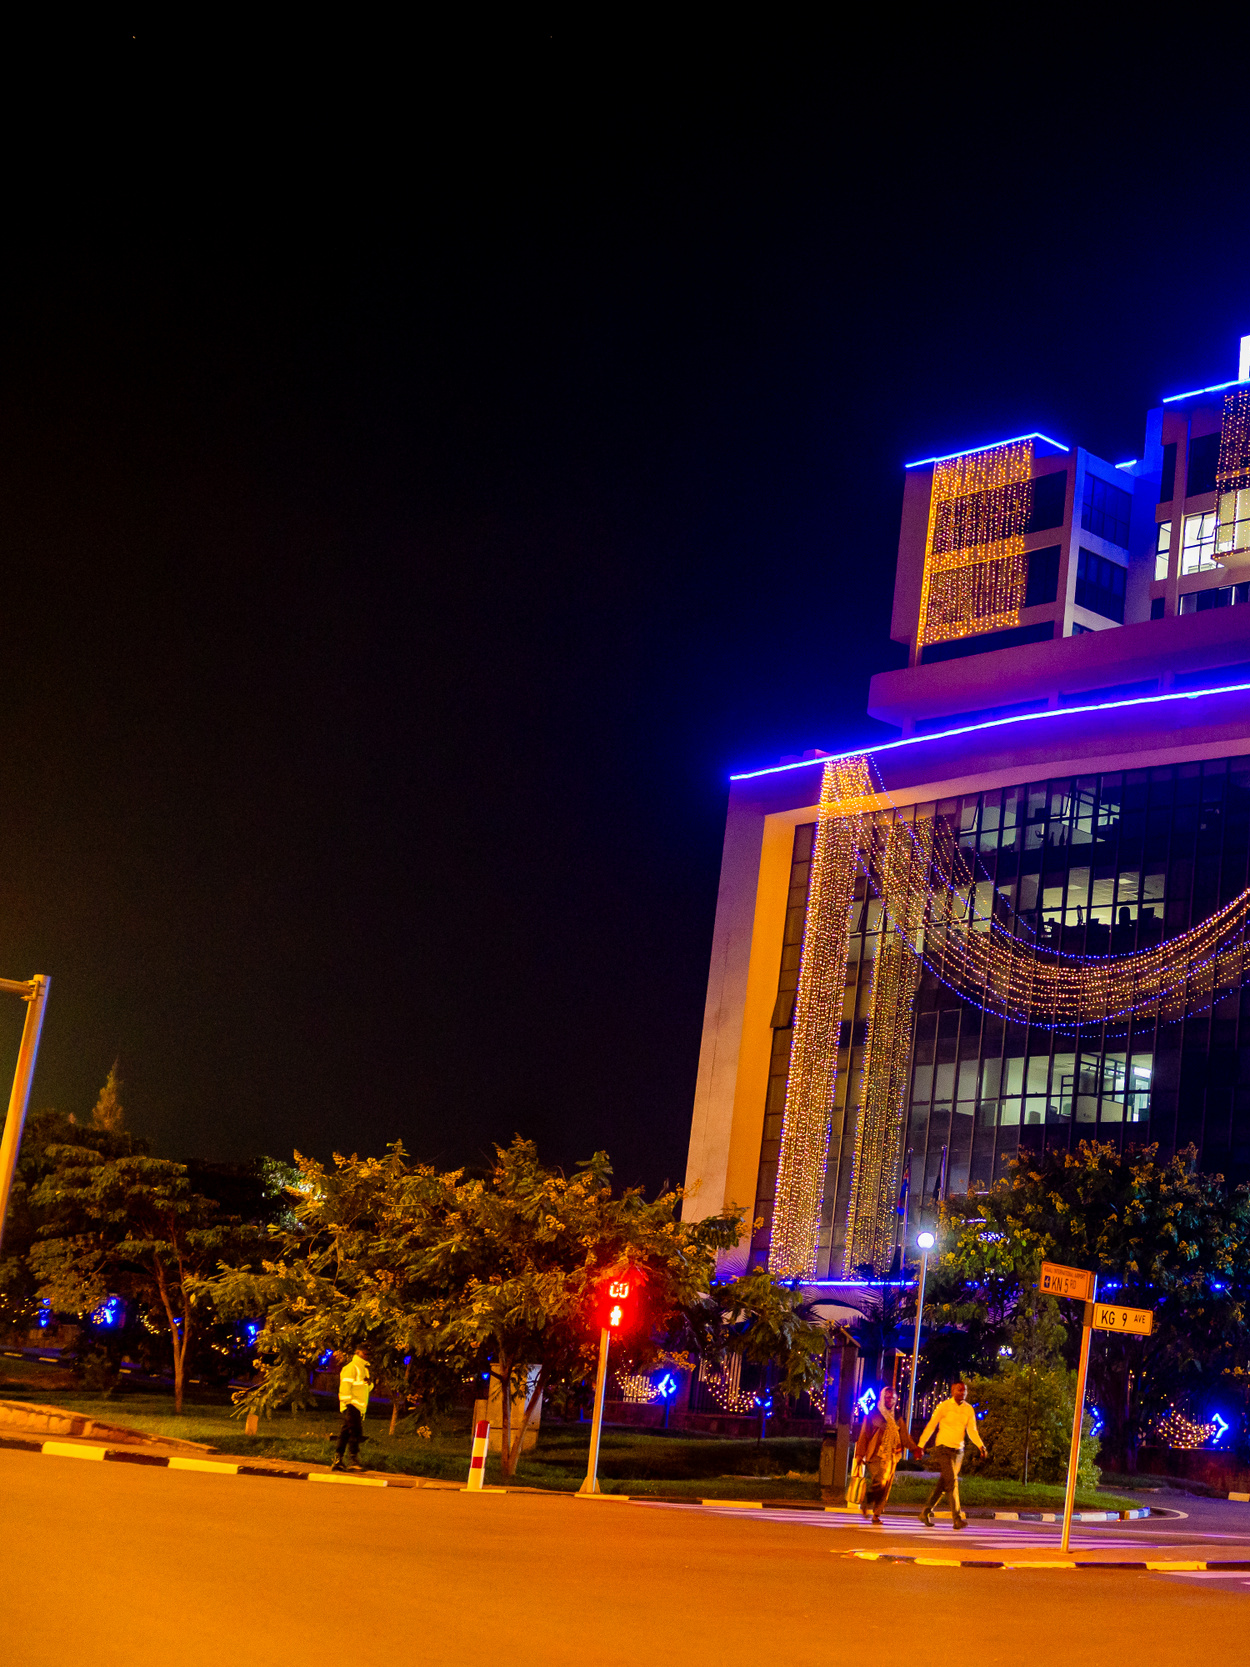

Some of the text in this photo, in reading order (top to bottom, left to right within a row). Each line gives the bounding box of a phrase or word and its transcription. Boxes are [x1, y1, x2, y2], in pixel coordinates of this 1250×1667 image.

[1051, 1276, 1077, 1294] KN 5 RD
[1101, 1310, 1146, 1327] KG 9 AVE
